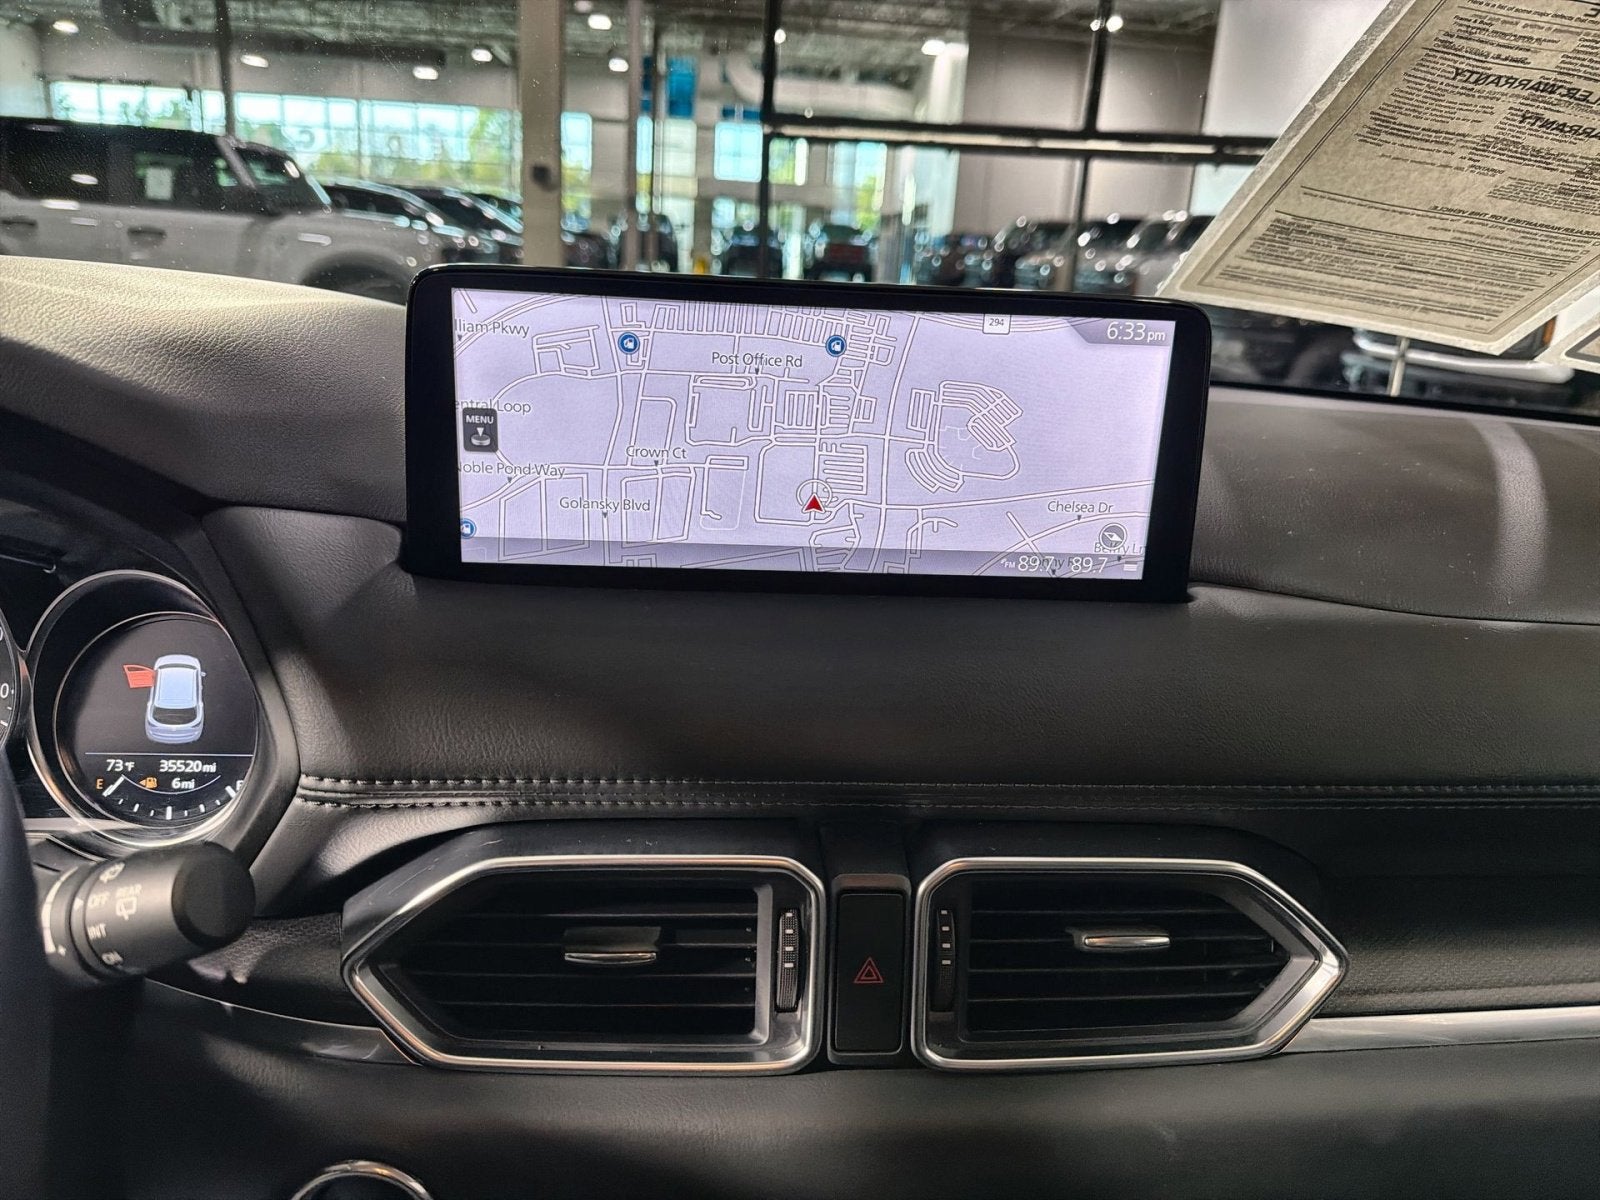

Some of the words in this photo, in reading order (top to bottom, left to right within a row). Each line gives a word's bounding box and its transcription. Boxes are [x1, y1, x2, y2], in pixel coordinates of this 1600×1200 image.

[988, 318, 1005, 326] 294
[492, 322, 530, 338] Pkwy
[712, 352, 739, 364] Post
[743, 353, 782, 366] Office
[786, 355, 803, 367] Rd
[497, 402, 532, 415] Loop
[466, 415, 494, 424] MENU
[626, 446, 669, 458] Crown
[673, 447, 687, 458] Ct
[497, 462, 531, 475] Pond
[534, 464, 565, 478] Way
[560, 497, 619, 513] Golansky
[623, 499, 650, 511] Blvd
[1048, 501, 1094, 512] Chelsea
[1099, 502, 1113, 513] Dr
[1018, 556, 1054, 572] 89.7
[1071, 557, 1108, 573] 89.7
[96, 779, 104, 790] E
[88, 891, 110, 908] OFF
